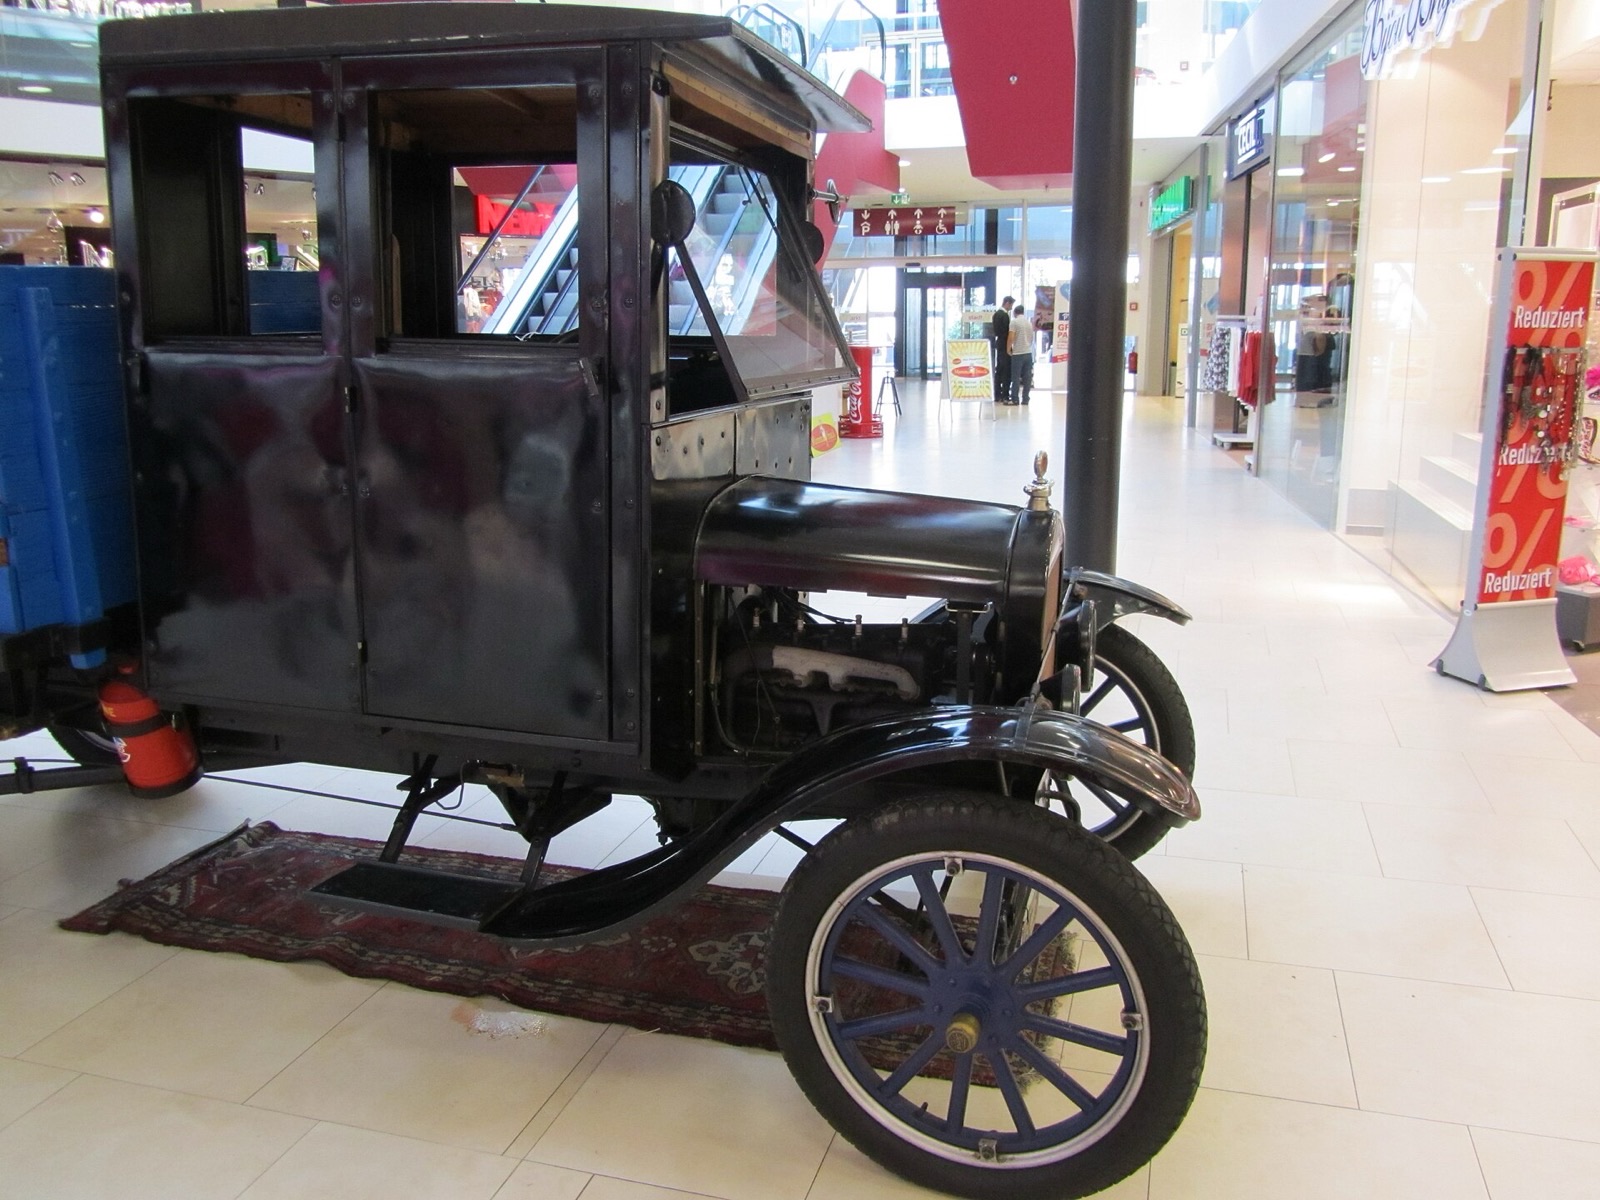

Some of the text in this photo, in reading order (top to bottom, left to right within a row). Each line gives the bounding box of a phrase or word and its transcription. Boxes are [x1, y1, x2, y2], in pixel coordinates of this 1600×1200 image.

[1238, 119, 1256, 156] CECIL
[1514, 305, 1585, 330] Reduziert
[1498, 442, 1568, 466] Reduzet
[1483, 567, 1553, 594] Reduziert
